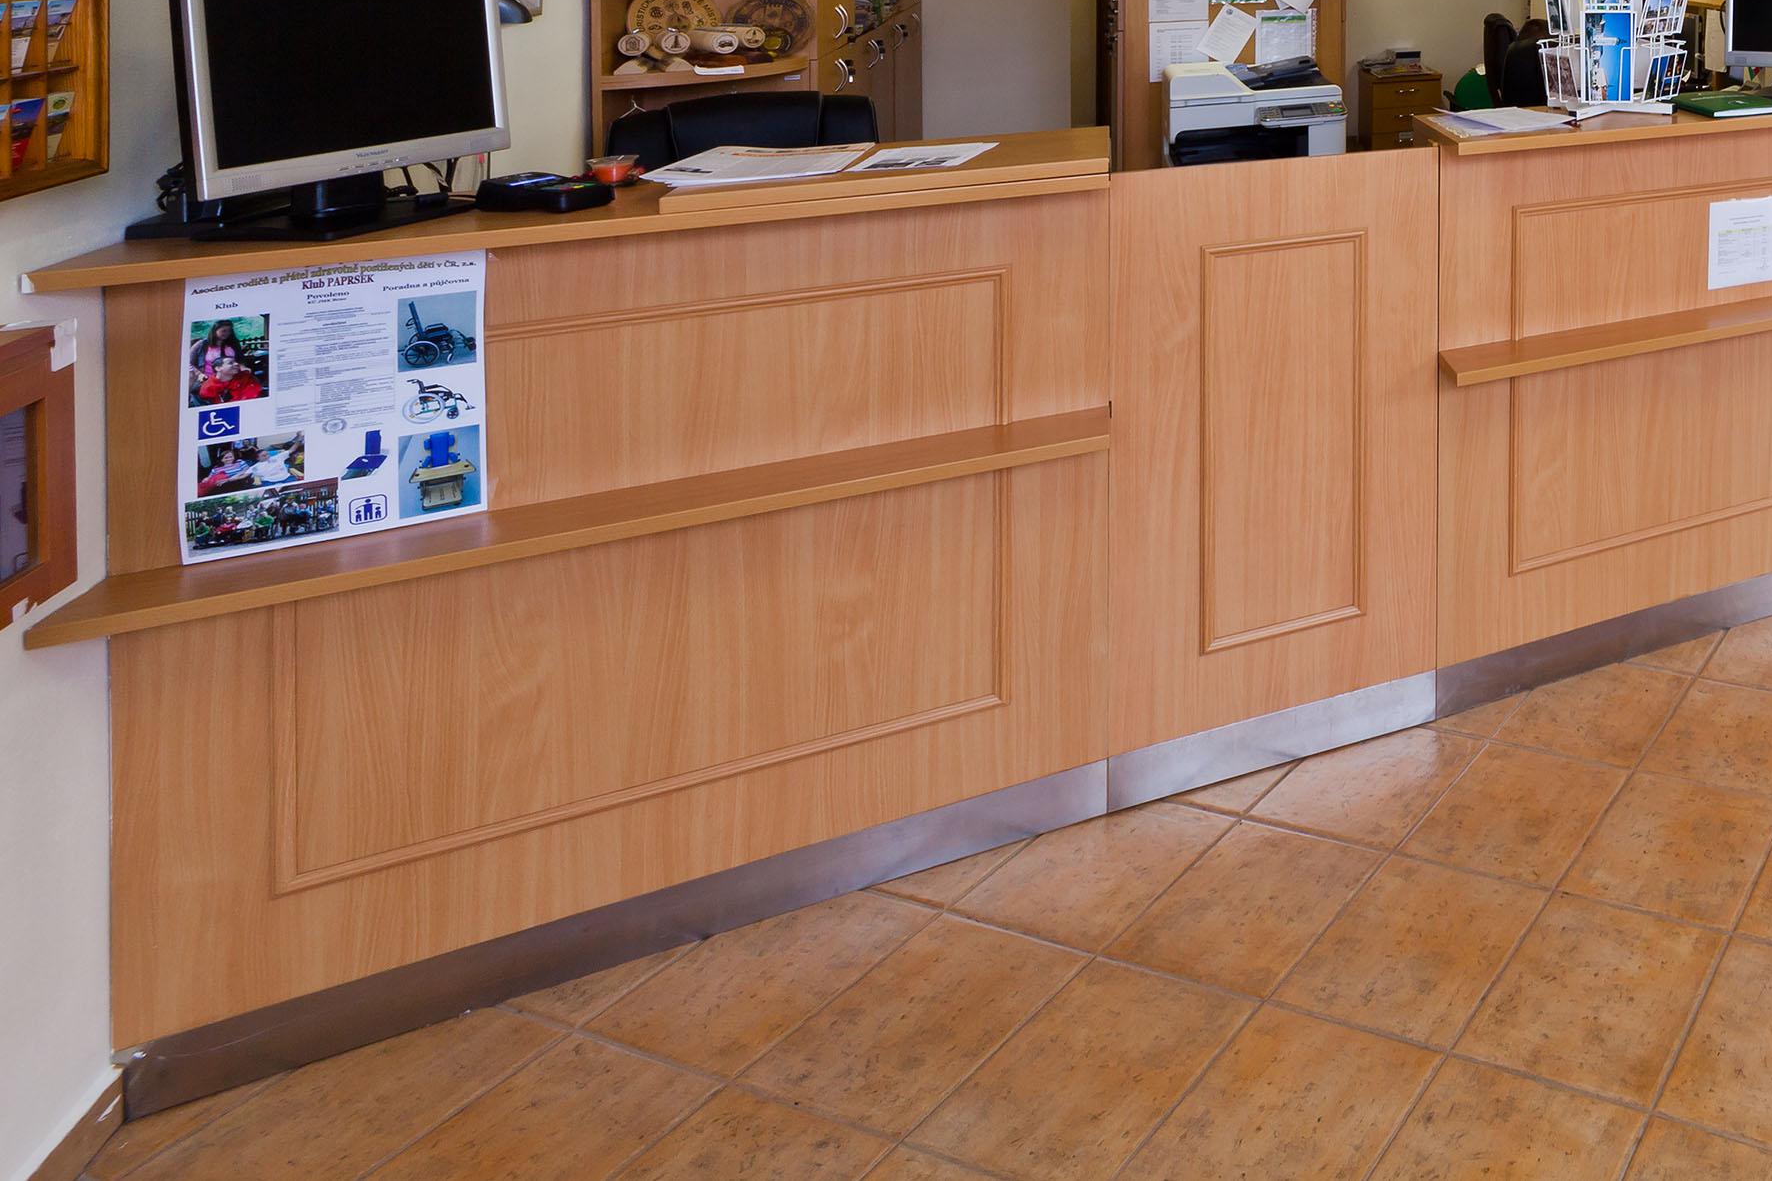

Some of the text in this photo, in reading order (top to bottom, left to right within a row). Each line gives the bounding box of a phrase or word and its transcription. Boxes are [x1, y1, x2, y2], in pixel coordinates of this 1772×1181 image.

[302, 273, 375, 290] Klub PAPRSEK
[191, 284, 236, 295] Asociace
[382, 283, 421, 292] Poradna
[306, 291, 350, 300] Povoleno
[214, 302, 239, 310] Klub
